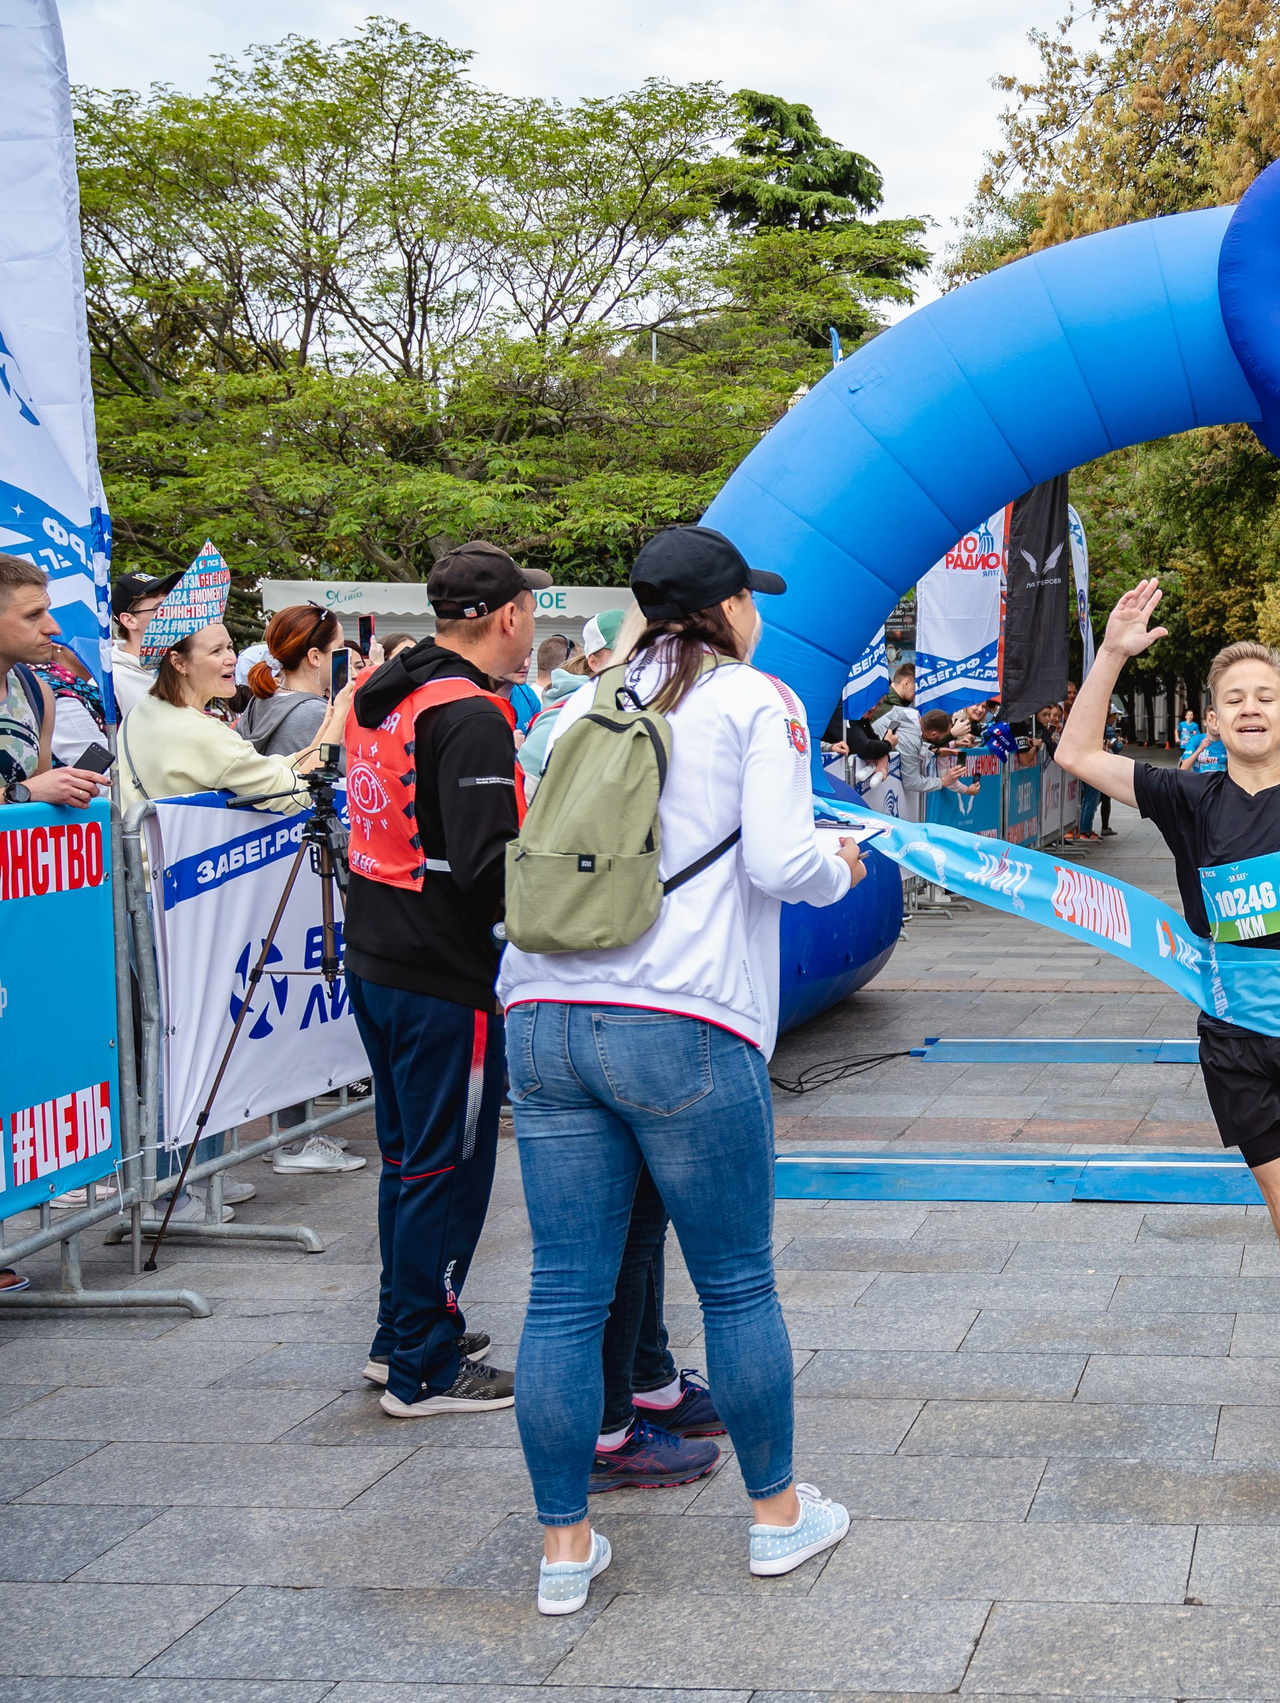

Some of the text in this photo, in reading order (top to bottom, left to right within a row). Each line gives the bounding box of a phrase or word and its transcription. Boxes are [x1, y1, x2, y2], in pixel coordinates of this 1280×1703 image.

[945, 552, 1000, 571] РАДИО
[189, 588, 224, 604] #МОМЕНТ
[196, 822, 306, 885] ЗАБЕГ.РФ
[1051, 866, 1132, 949] ФИНИШ
[1215, 881, 1277, 918] 10246
[1235, 914, 1267, 941] 1КМ
[1211, 975, 1229, 1018] #ЦЕЛЬ
[12, 1080, 112, 1188] #ЦЕЛЬ
